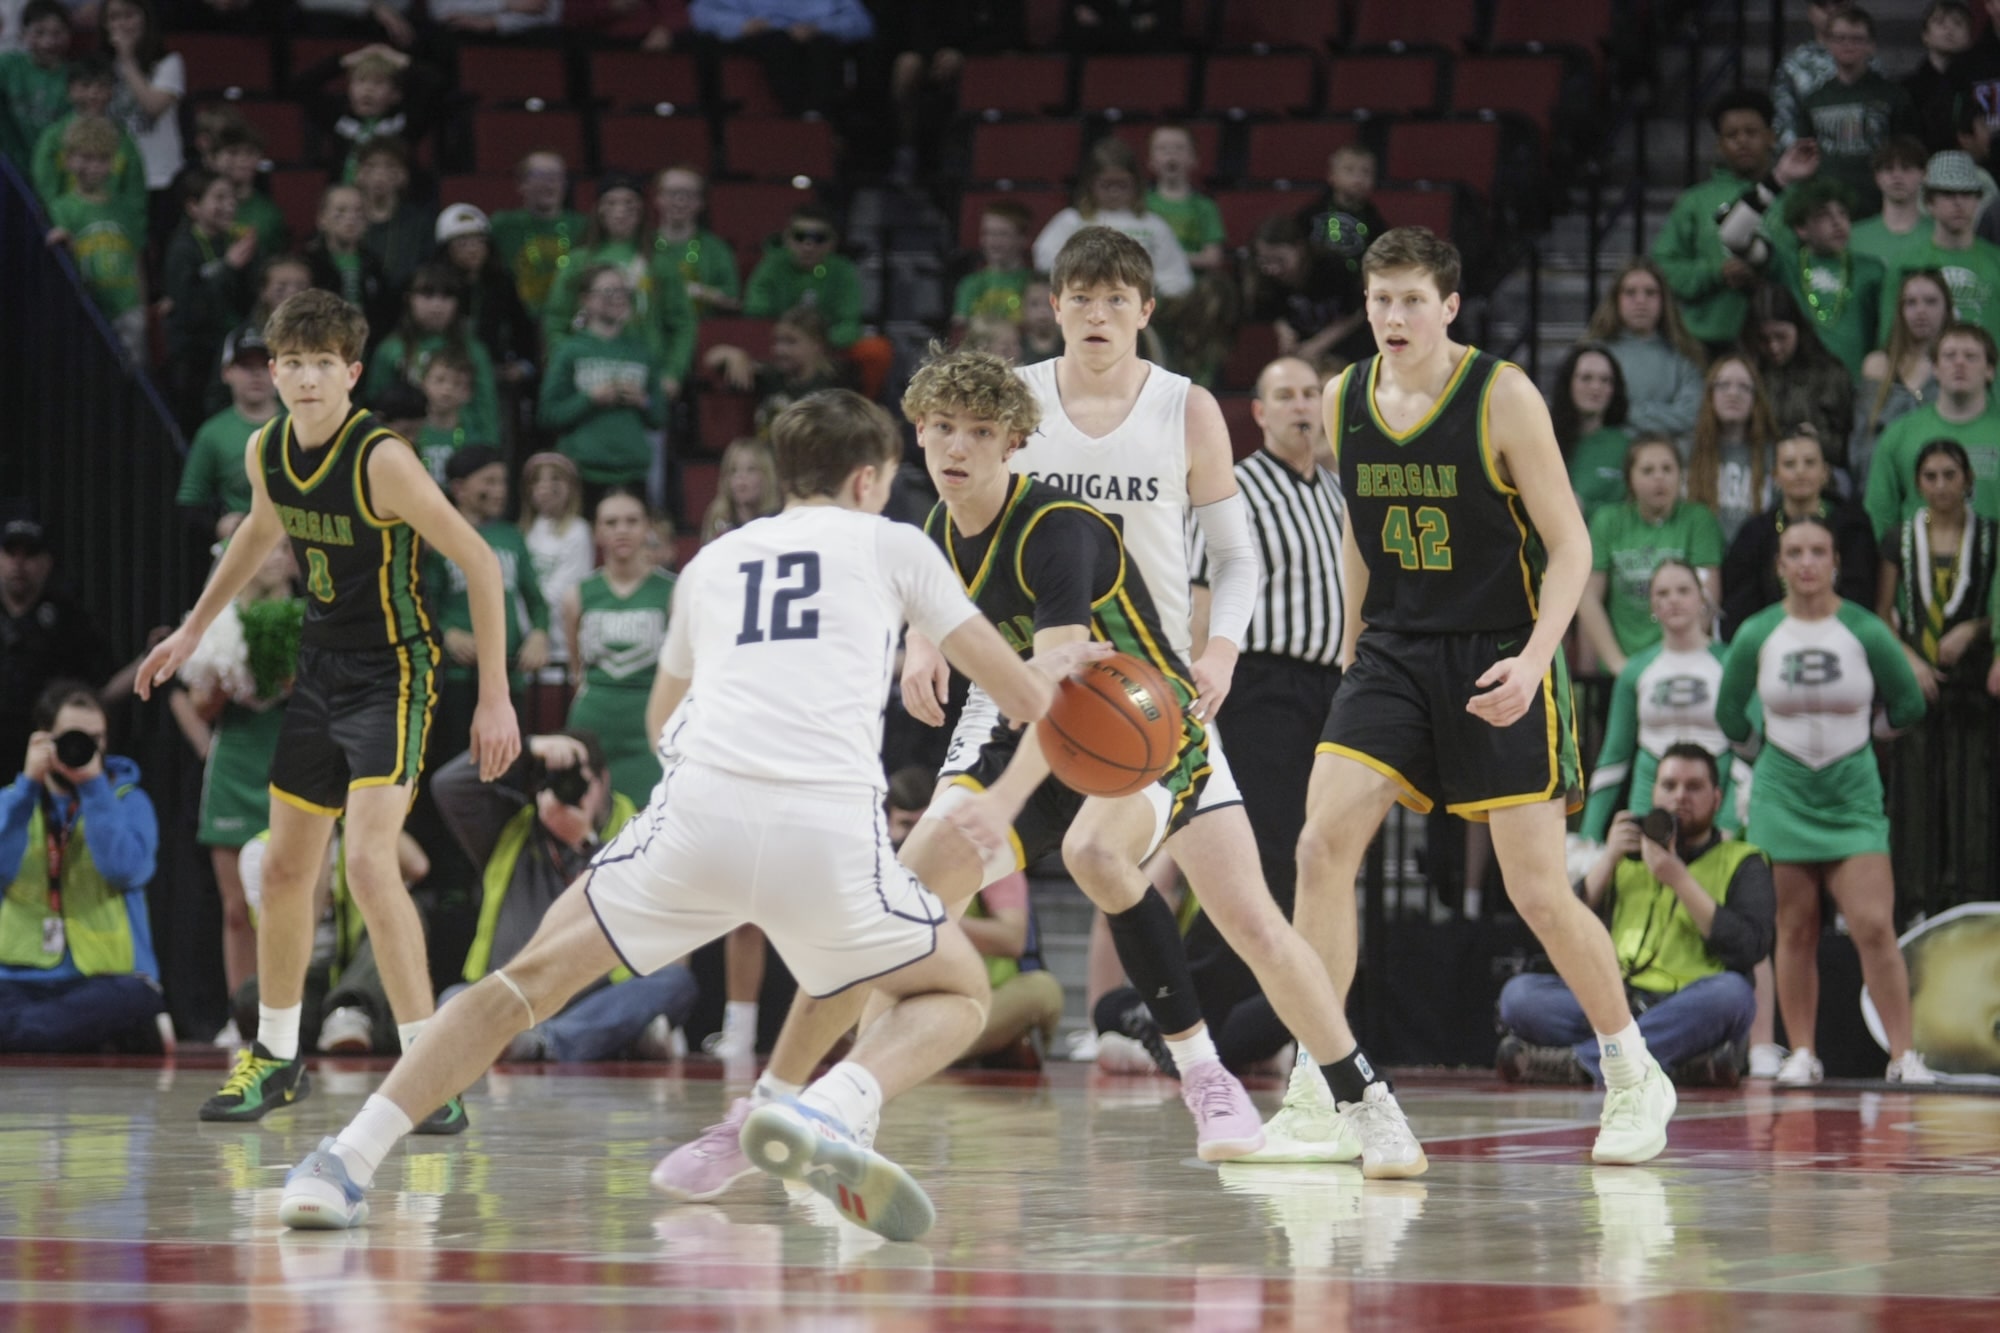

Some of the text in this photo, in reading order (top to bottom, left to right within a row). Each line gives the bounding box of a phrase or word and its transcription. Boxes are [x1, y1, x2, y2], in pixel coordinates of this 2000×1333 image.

[1027, 472, 1159, 501] OUGARS
[1356, 463, 1458, 497] BERGAN
[274, 503, 354, 546] ERGAN
[1382, 505, 1452, 570] 42
[305, 547, 336, 603] 0
[736, 550, 820, 645] 12
